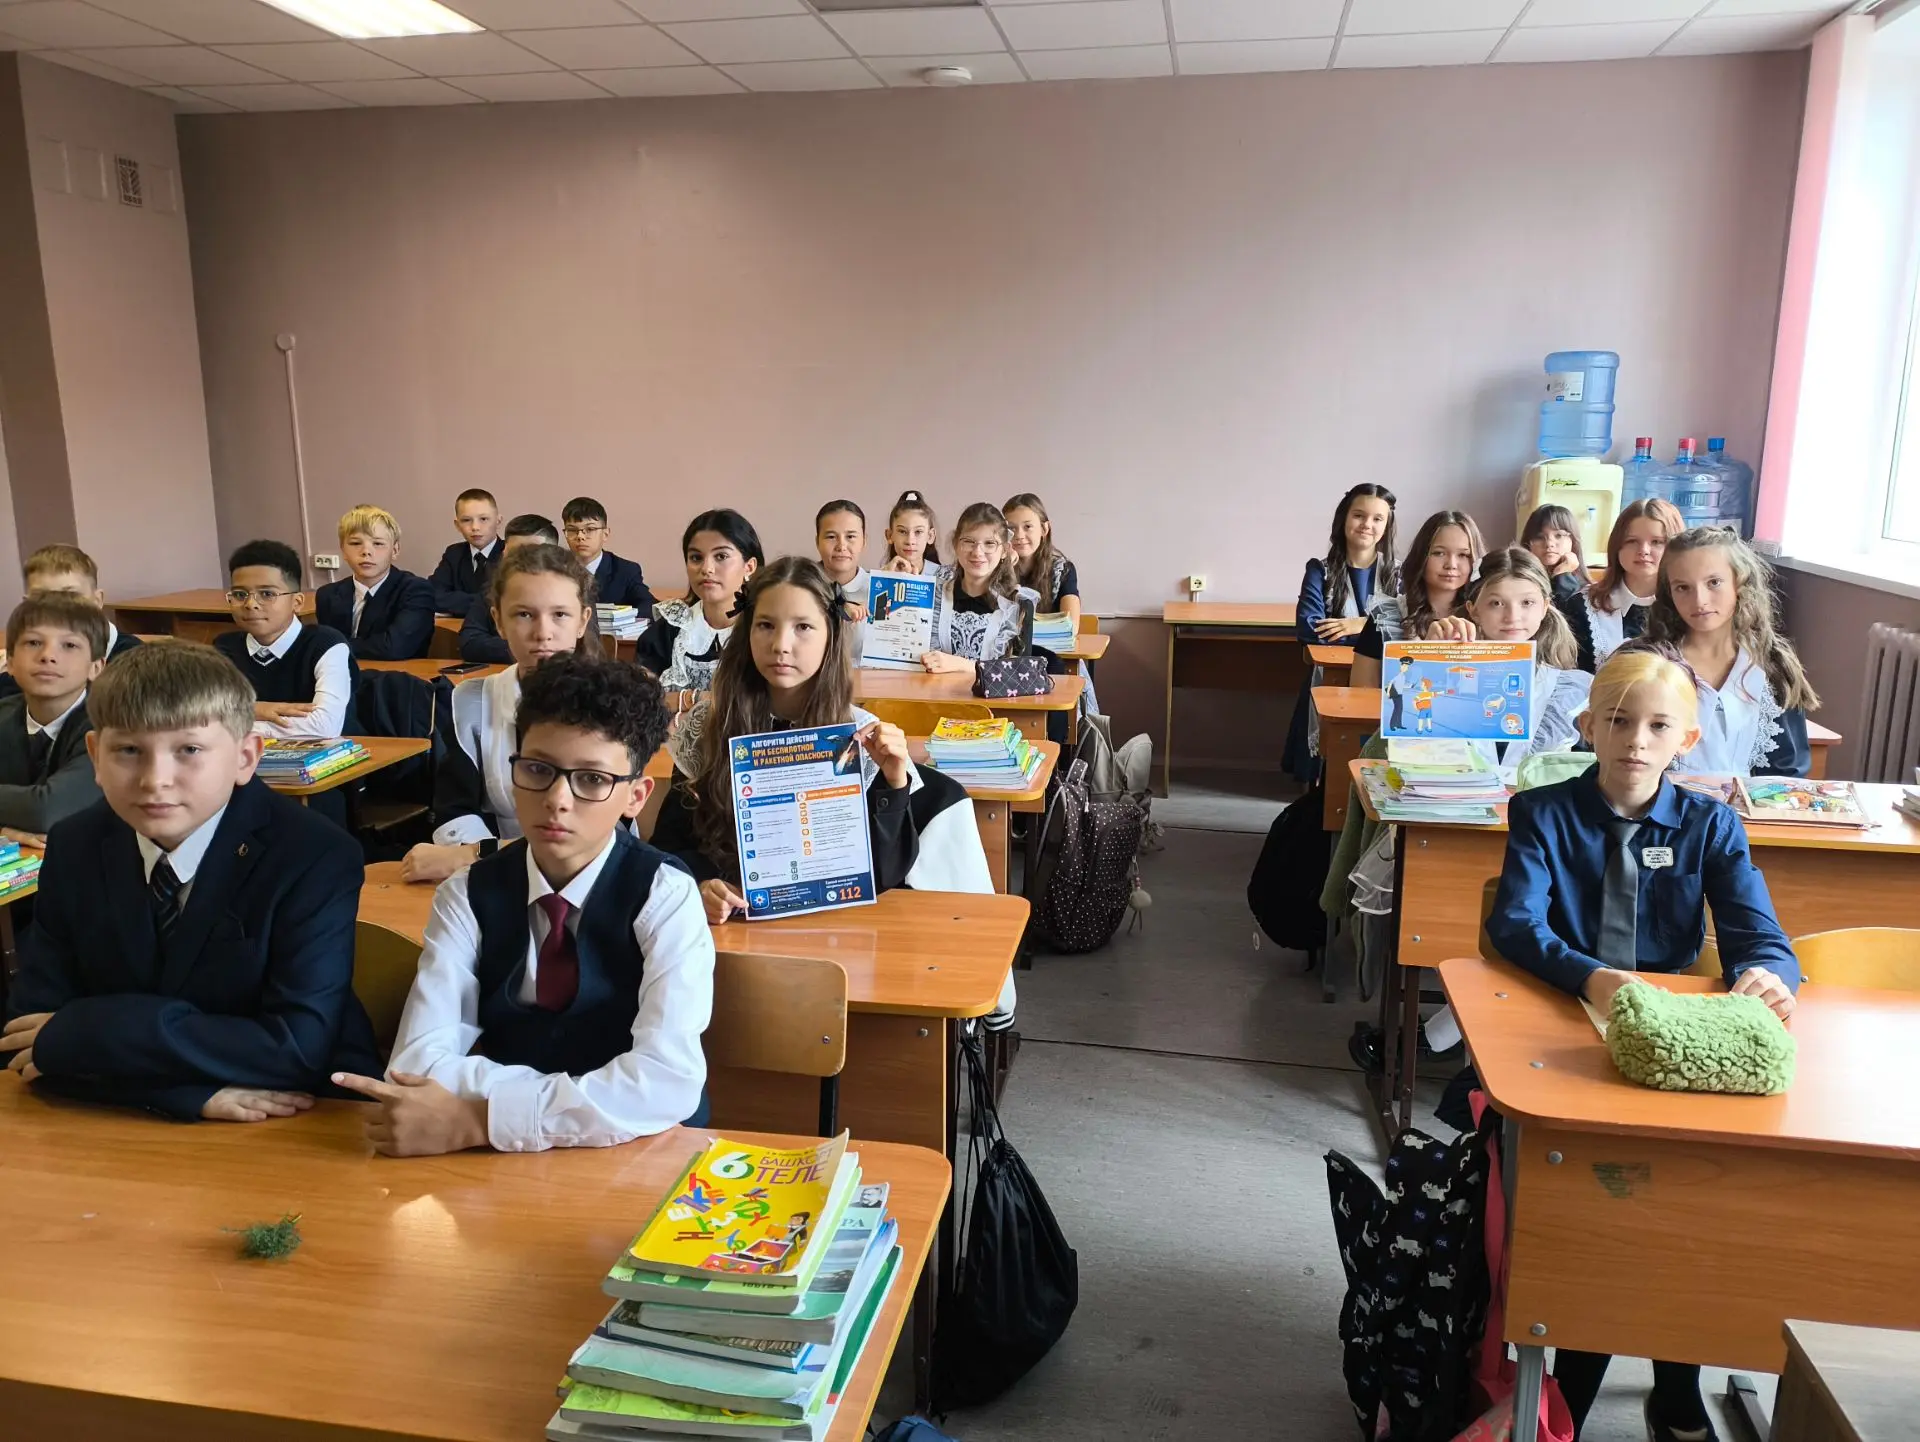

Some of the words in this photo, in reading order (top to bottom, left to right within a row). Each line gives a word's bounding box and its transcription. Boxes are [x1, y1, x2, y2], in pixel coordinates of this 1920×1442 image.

[894, 582, 905, 602] 10
[752, 738, 785, 748] АЛГОРИТМ
[786, 733, 818, 746] ДЕЙСТВИЙ
[752, 749, 766, 757] ПРИ
[760, 754, 794, 766] РАКЕТНОЙ
[796, 750, 833, 762] ОПАСНОСТИ
[840, 886, 861, 900] 112
[709, 1152, 755, 1180] 6
[756, 1164, 824, 1184] ТЕЛЕ
